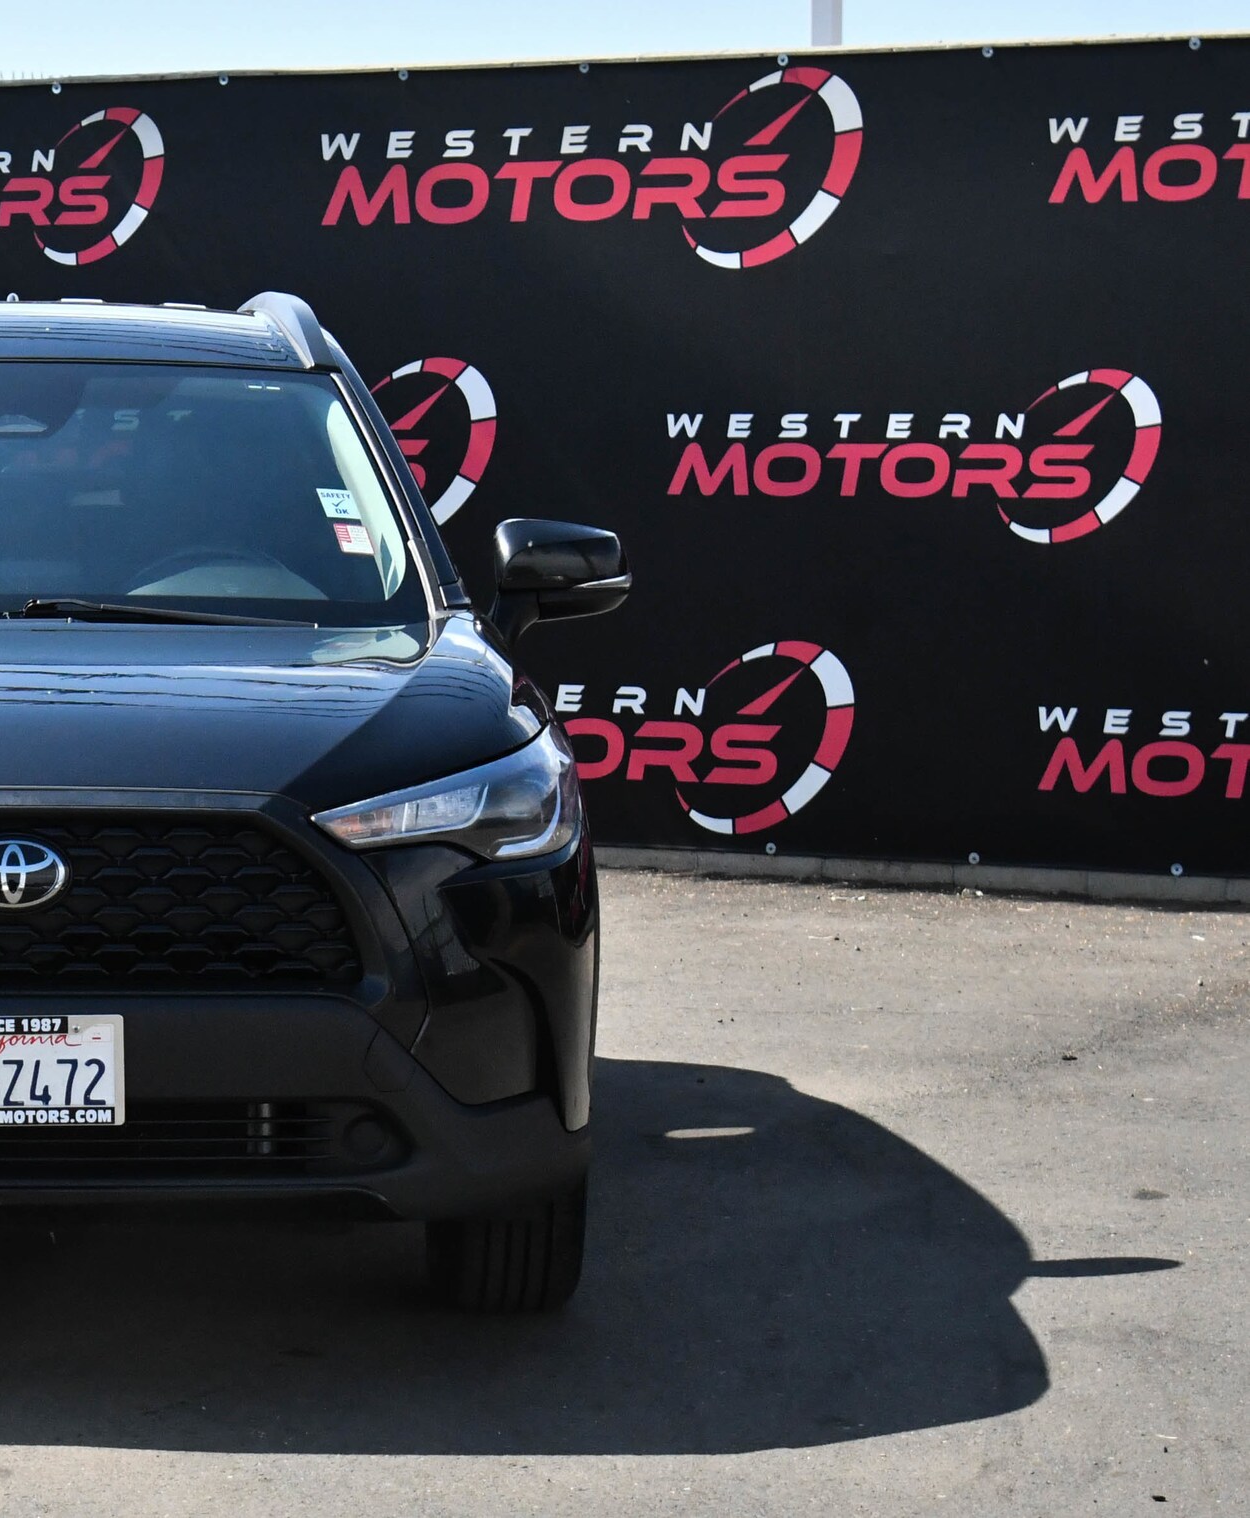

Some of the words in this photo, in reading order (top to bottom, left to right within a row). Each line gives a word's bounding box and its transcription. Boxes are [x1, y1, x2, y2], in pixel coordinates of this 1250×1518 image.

[322, 122, 712, 160] WESTERN
[323, 154, 788, 227] MOTORS
[667, 414, 1024, 439] WESTERN
[668, 443, 1094, 498] MOTORS
[320, 492, 351, 500] SAFETY
[1039, 706, 1248, 738] WEST
[21, 1018, 62, 1032] 1987
